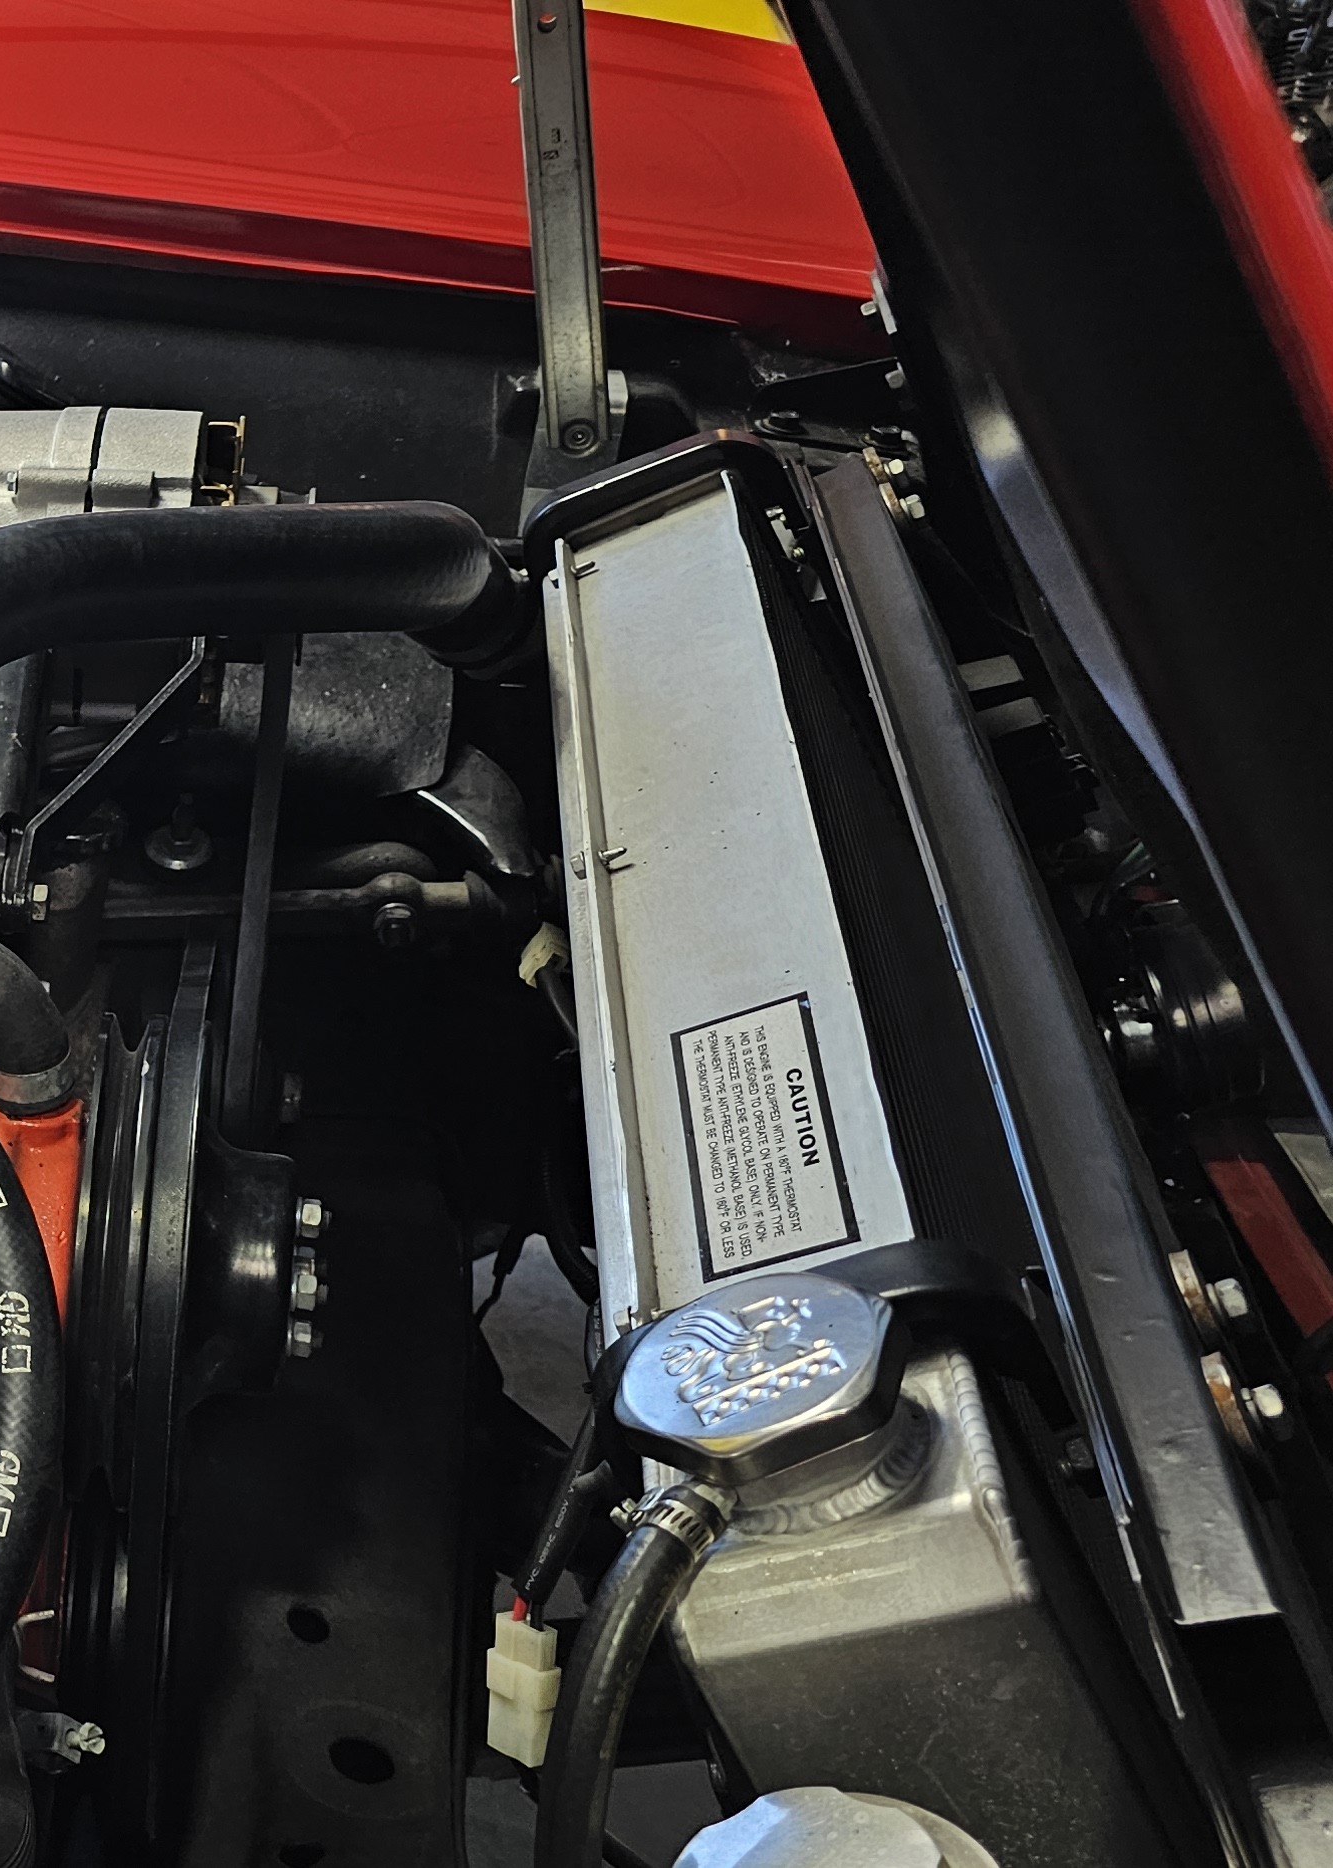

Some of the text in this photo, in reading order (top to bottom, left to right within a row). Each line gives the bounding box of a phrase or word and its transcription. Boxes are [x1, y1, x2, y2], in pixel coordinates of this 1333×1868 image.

[754, 1025, 766, 1043] THIS
[693, 1039, 704, 1055] THE
[707, 1030, 723, 1074] PERMANENT
[724, 1035, 740, 1081] ANTI-FREEZE
[758, 1044, 771, 1071] ENGINE
[695, 1055, 712, 1102] THERMOSTAT
[714, 1075, 726, 1095] TYPE
[764, 1074, 773, 1082] IS
[703, 1104, 715, 1126] MUST
[729, 1083, 748, 1124] (ETHYLENE
[765, 1084, 781, 1121] EQUIPPED
[717, 1097, 734, 1145] ANTI-FREEZE
[786, 1068, 820, 1167] CAUTION
[706, 1127, 717, 1139] BE
[739, 1031, 785, 1238] AND IS DESIGNED TO OPERATE ON PERMANENT TYPE
[739, 1126, 753, 1157] GLYCOL
[772, 1123, 785, 1144] WITH
[708, 1141, 723, 1180] CHANGED
[723, 1147, 742, 1193] (METHANOL
[744, 1158, 758, 1183] BASE)
[714, 1181, 725, 1194] TO
[733, 1194, 747, 1220] BASE)
[753, 1210, 764, 1218] IF
[782, 1177, 802, 1232] THERMOSTAT
[720, 1220, 732, 1235] OR
[738, 1221, 748, 1231] IS
[722, 1235, 735, 1259] LESS
[525, 1568, 540, 1590] PVC
